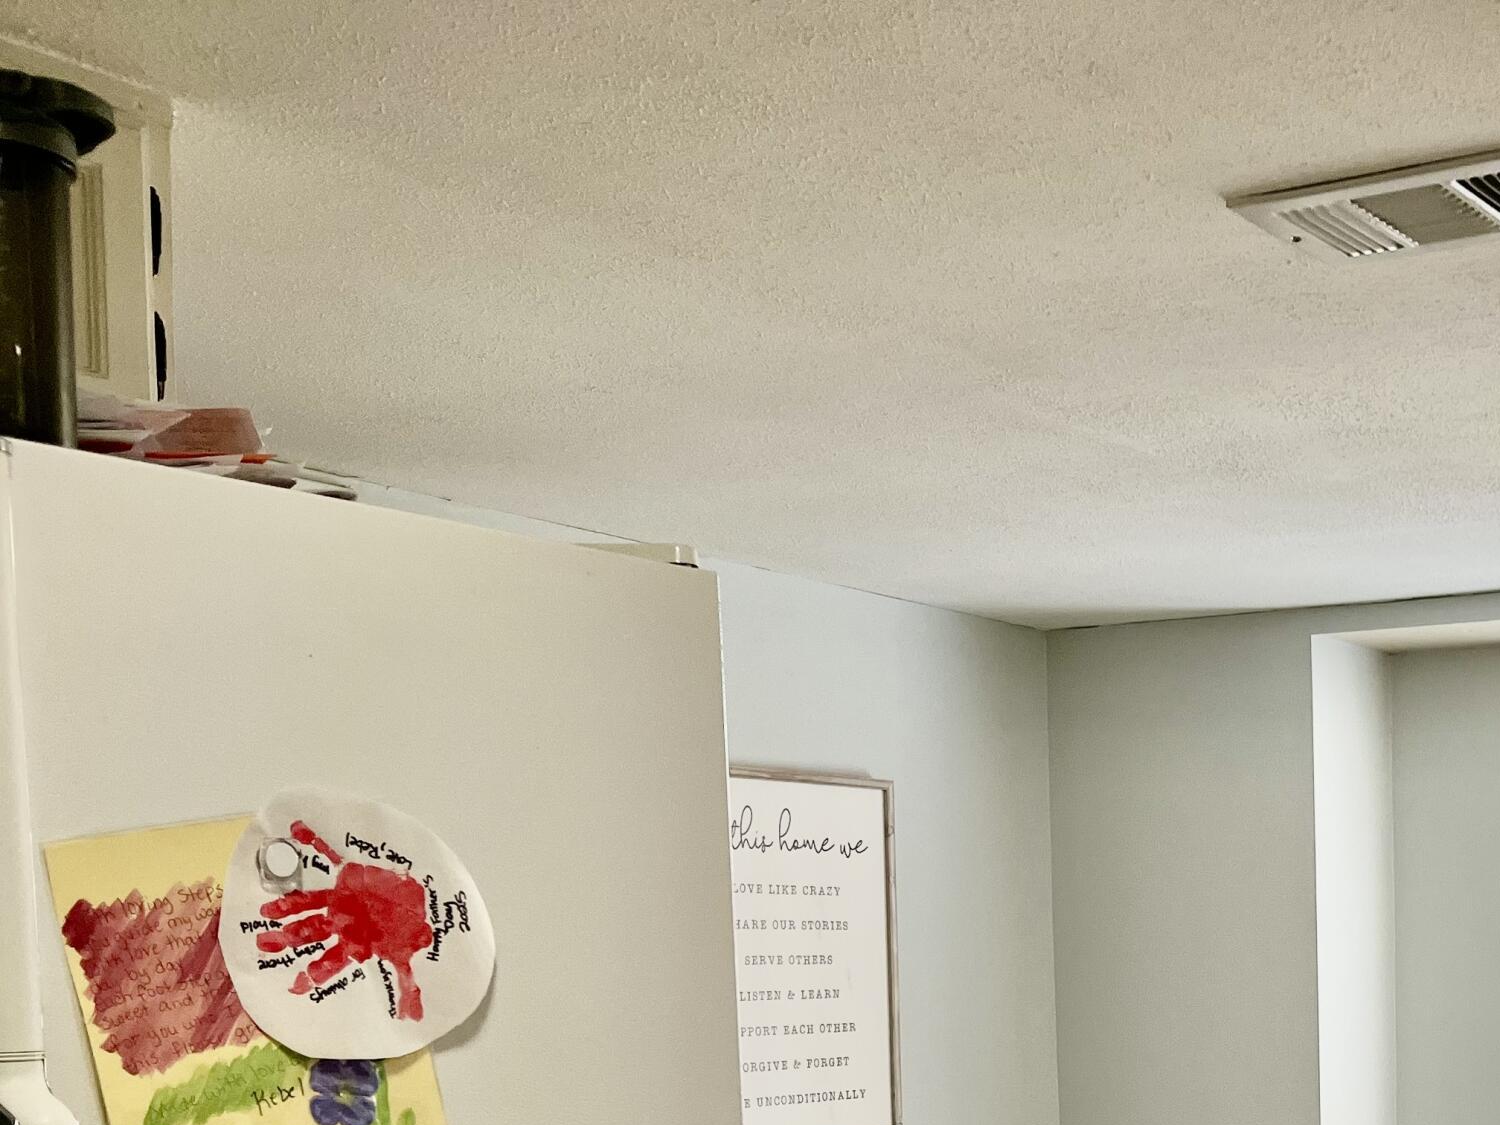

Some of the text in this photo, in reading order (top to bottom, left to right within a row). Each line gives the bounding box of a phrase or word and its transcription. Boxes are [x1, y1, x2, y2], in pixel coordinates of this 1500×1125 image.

[731, 804, 869, 860] this home we
[345, 832, 381, 859] Rebel
[768, 884, 798, 896] LIKE
[802, 884, 842, 898] CRAZY
[442, 901, 459, 931] Day
[735, 919, 849, 932] HARE OUR STORIES
[744, 954, 834, 966] SERVE OTHERS
[739, 989, 841, 1002] LISTEN & LEARN
[740, 1022, 857, 1038] PPORT EACH OTHER
[742, 1056, 850, 1074] ORGIVE & FORGET
[250, 1076, 305, 1117] Rebel
[744, 1088, 867, 1109] E UNCONDITIONALLY
